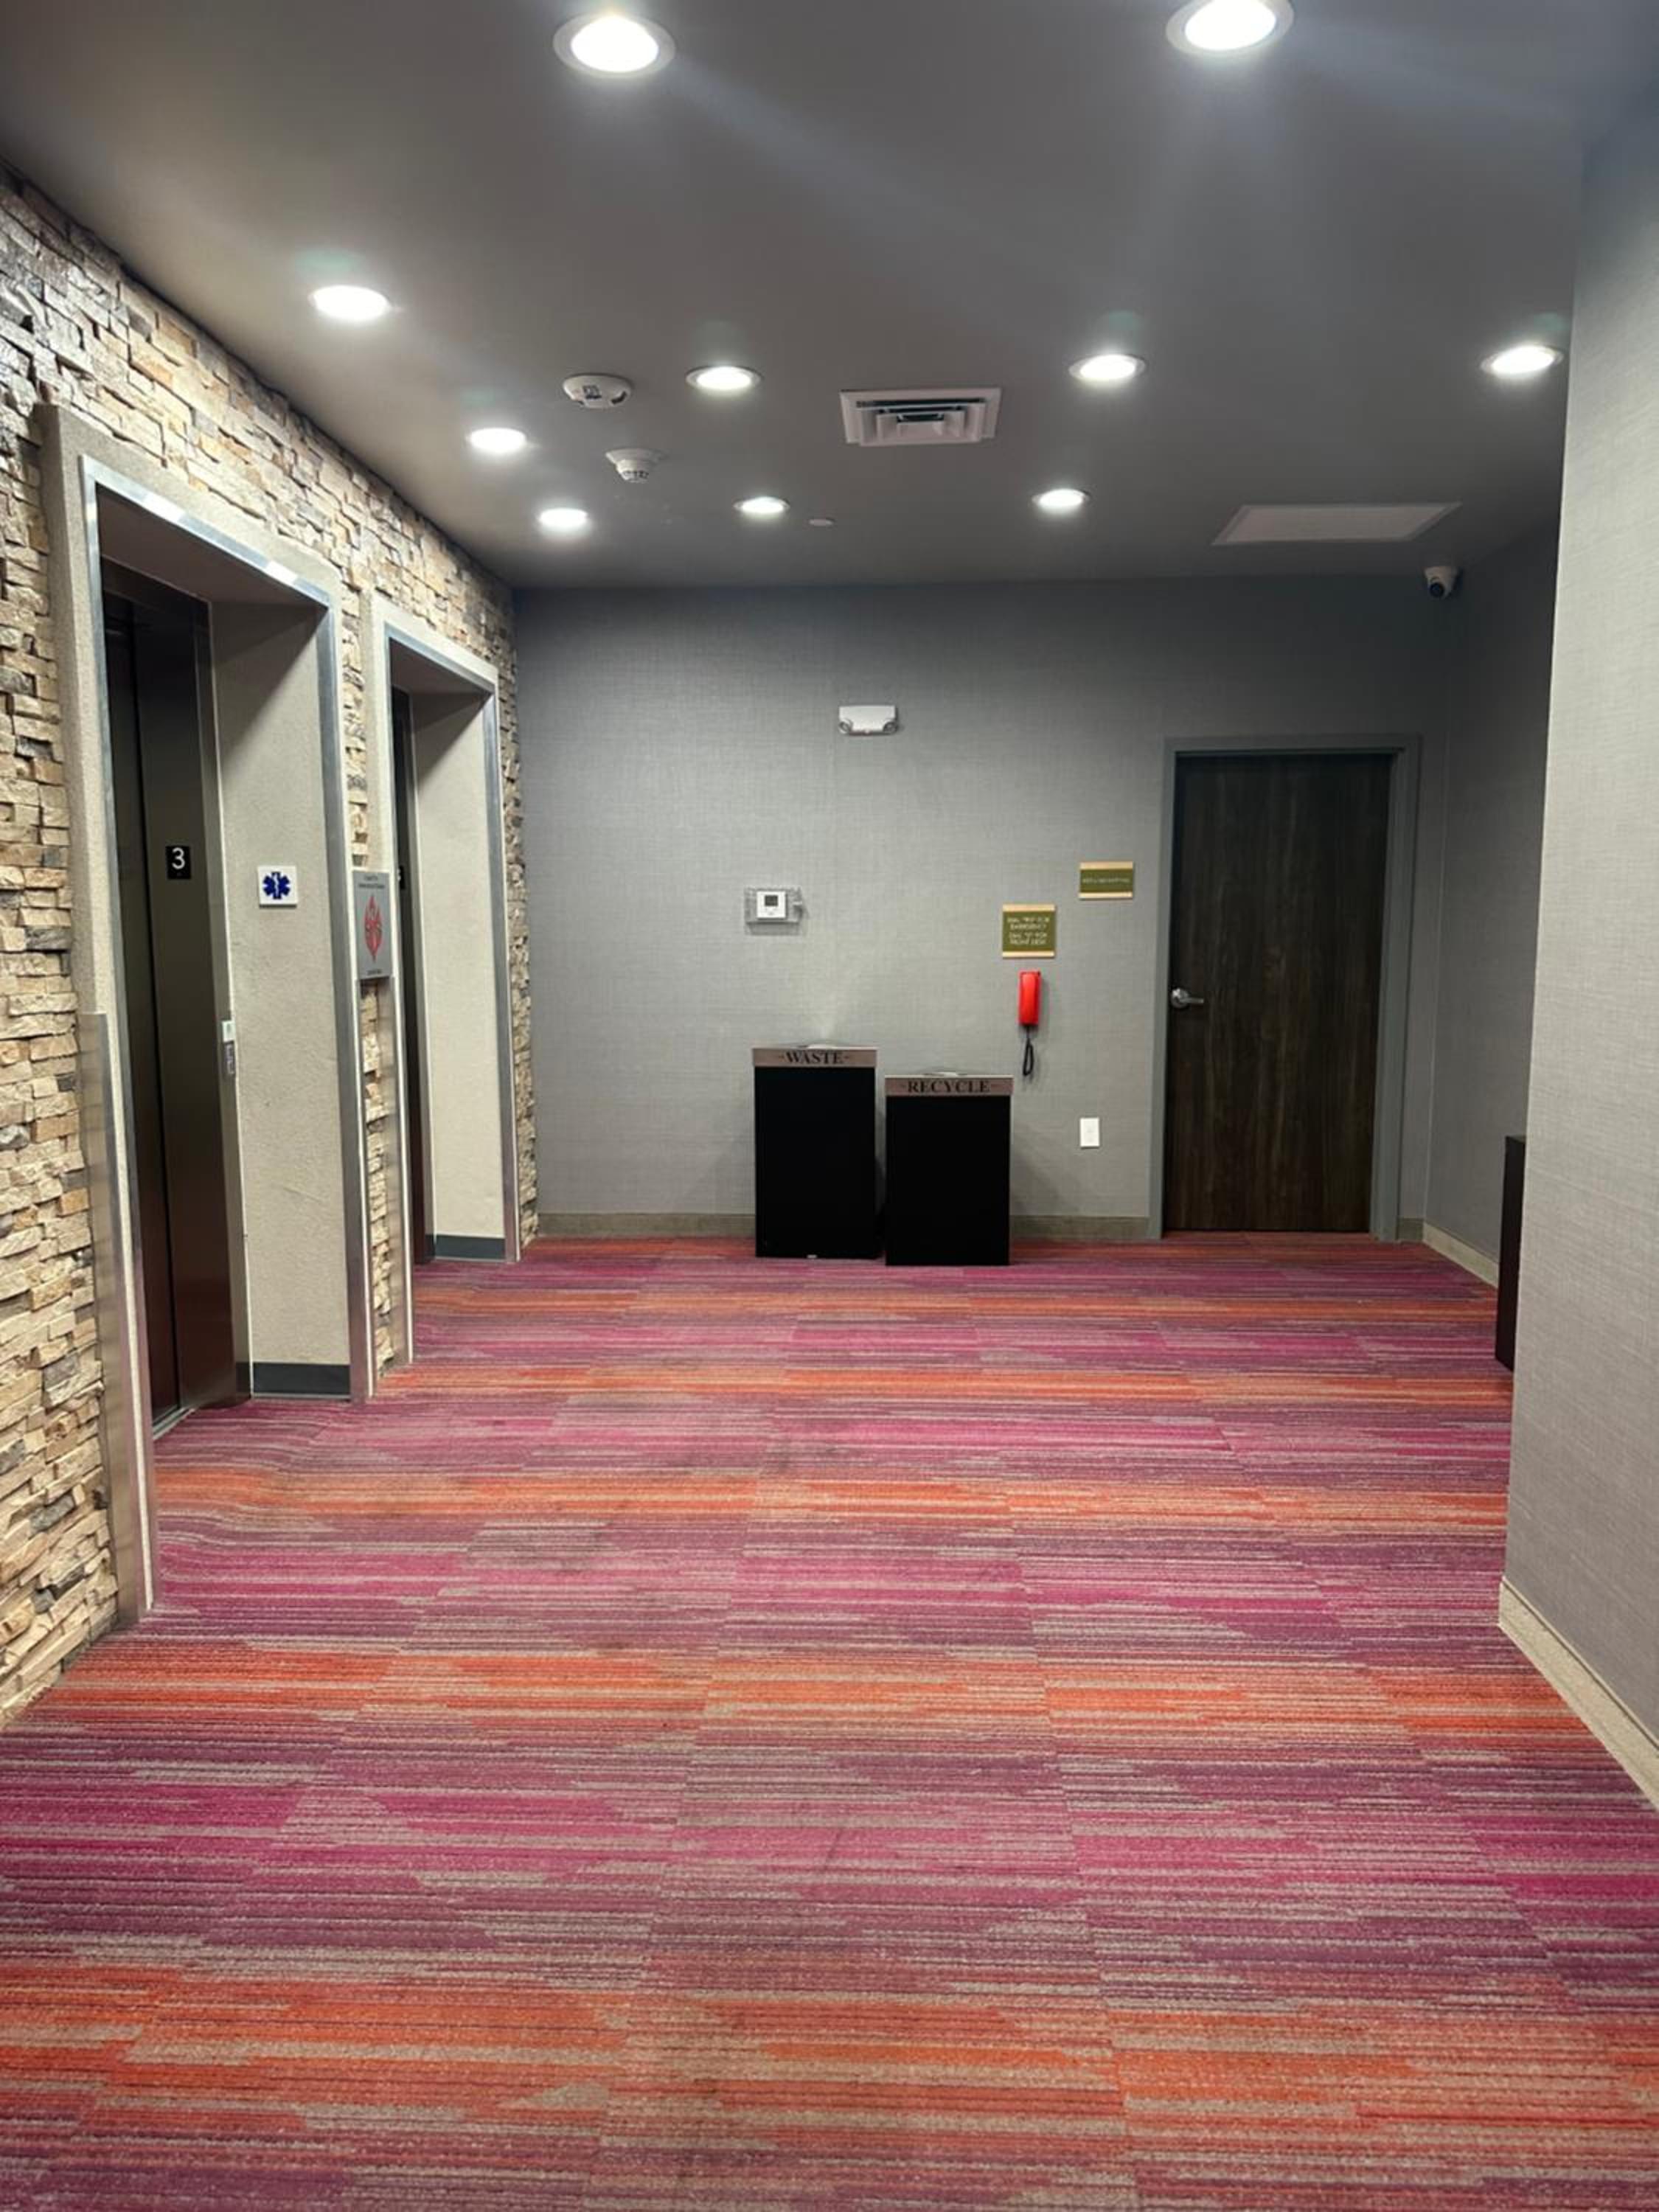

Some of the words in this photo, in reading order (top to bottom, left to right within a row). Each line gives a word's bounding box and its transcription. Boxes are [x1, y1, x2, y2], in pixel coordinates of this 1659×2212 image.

[172, 847, 185, 869] 3
[785, 1050, 844, 1064] WASTE
[908, 1080, 990, 1093] RECYCLE
